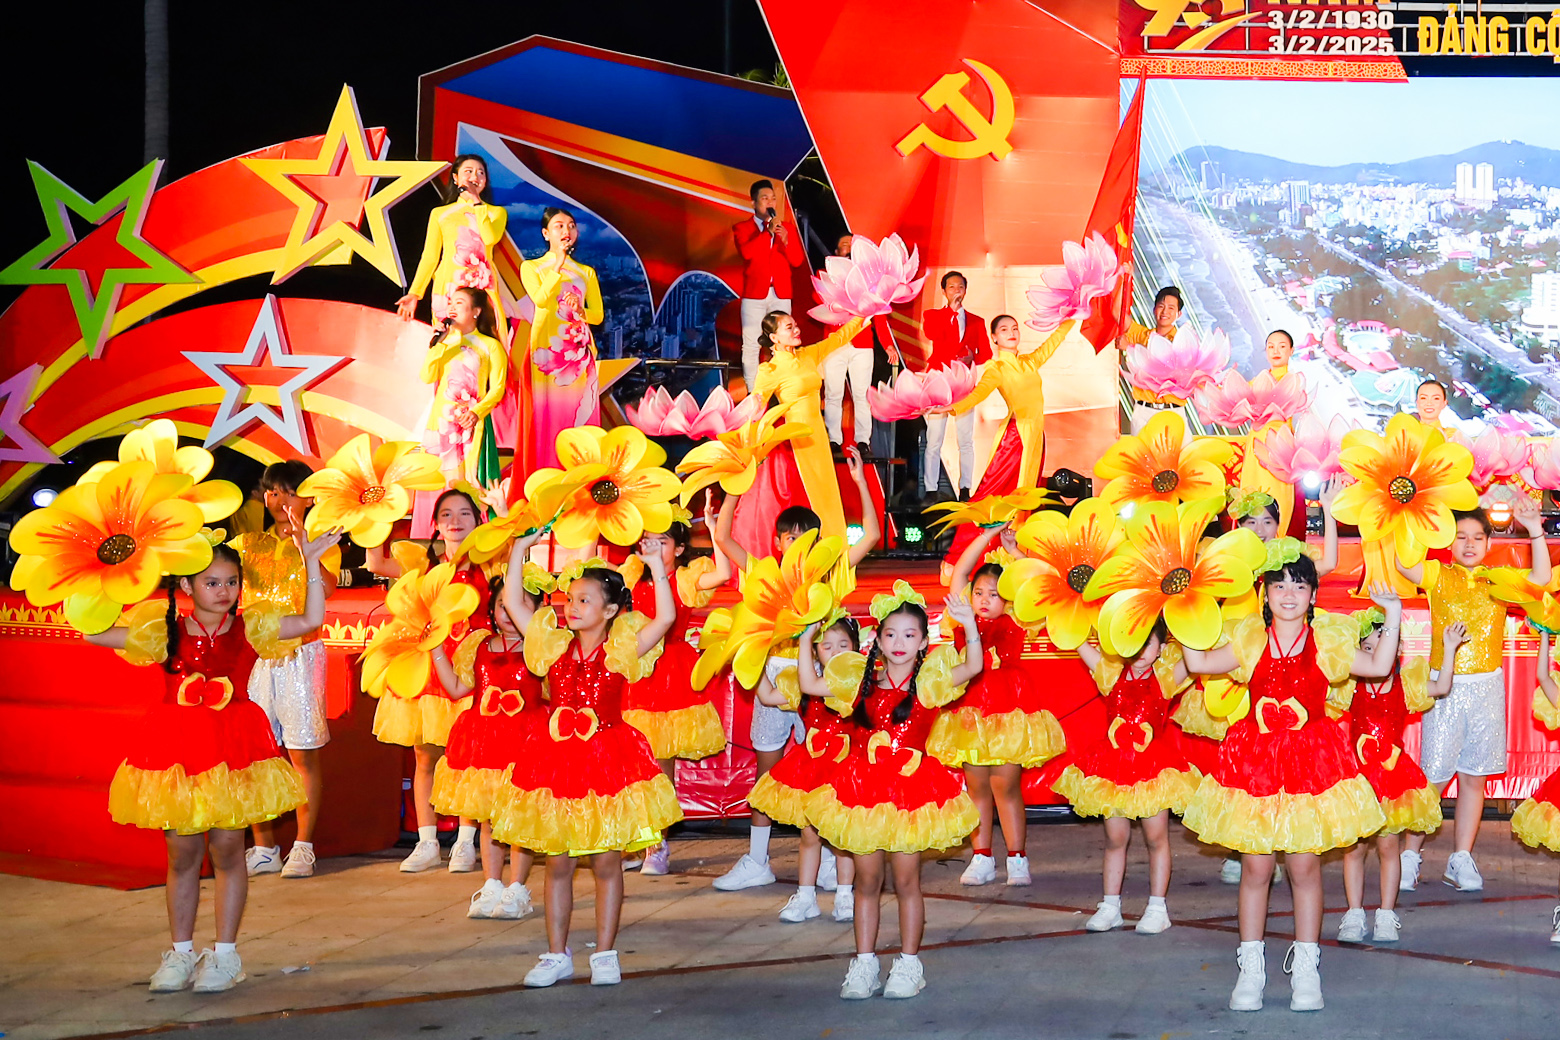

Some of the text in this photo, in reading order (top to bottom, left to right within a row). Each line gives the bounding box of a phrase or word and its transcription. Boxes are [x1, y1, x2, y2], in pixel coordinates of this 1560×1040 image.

[1267, 10, 1394, 29] 3/2/1930
[1417, 3, 1510, 56] ĐẢNG
[1267, 35, 1394, 55] 3/2/2025
